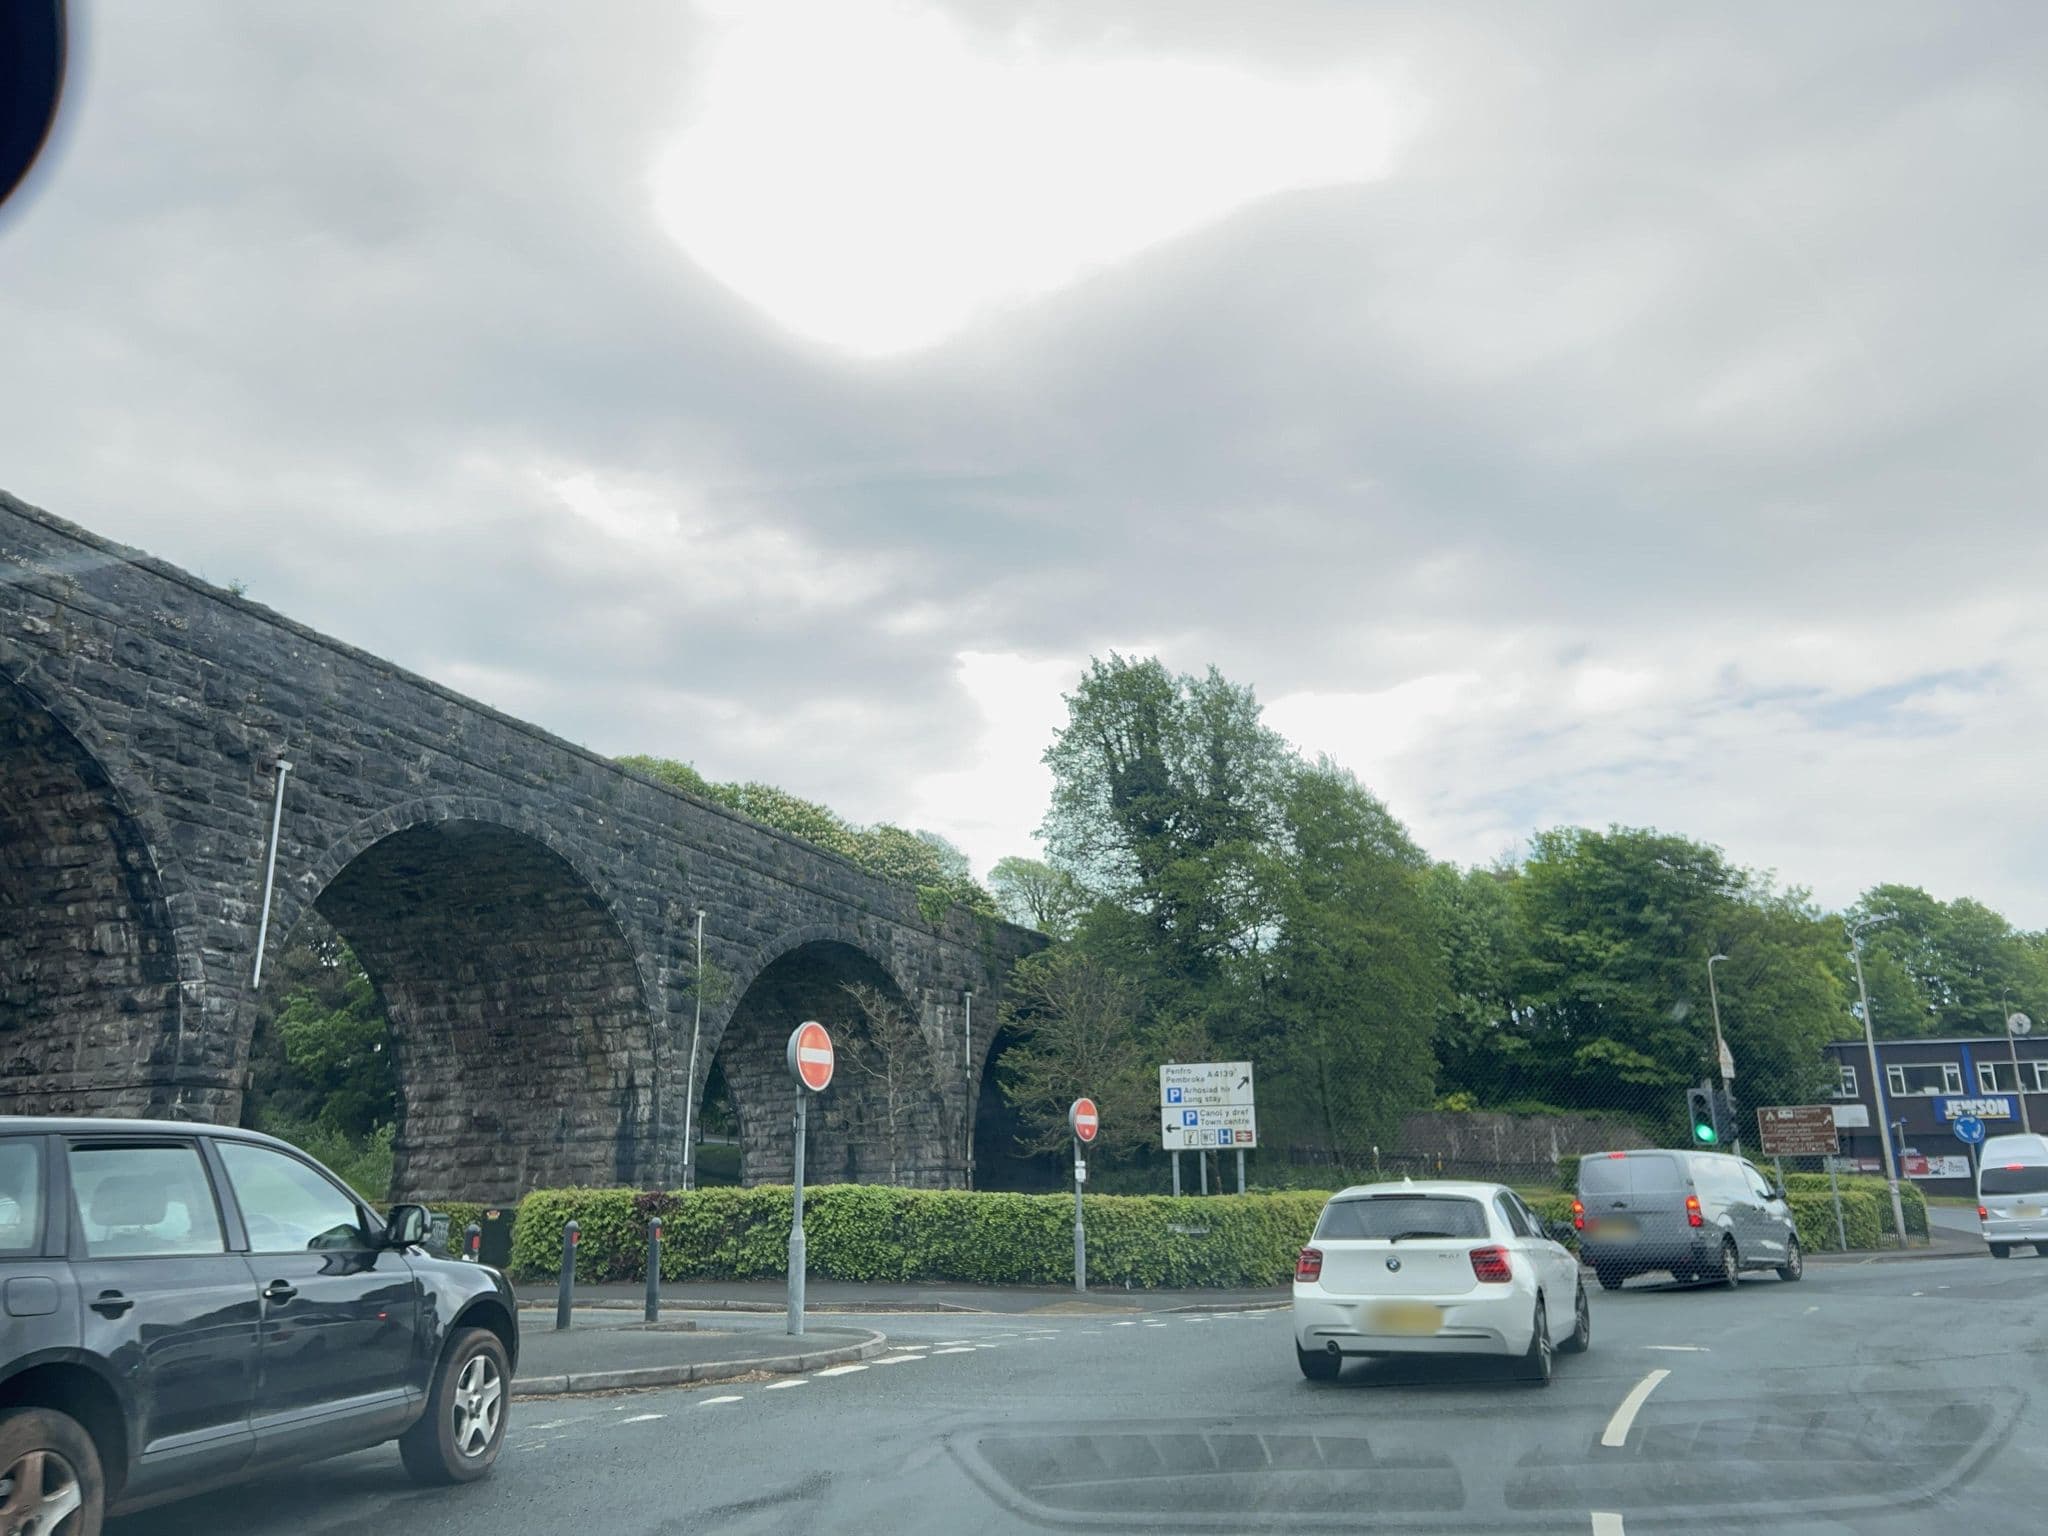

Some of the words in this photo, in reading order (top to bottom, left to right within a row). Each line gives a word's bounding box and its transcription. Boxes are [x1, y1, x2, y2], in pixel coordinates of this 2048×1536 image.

[1166, 1075, 1205, 1083] Pembroke
[1945, 1098, 2010, 1115] JEWSON
[1202, 1133, 1215, 1141] WC
